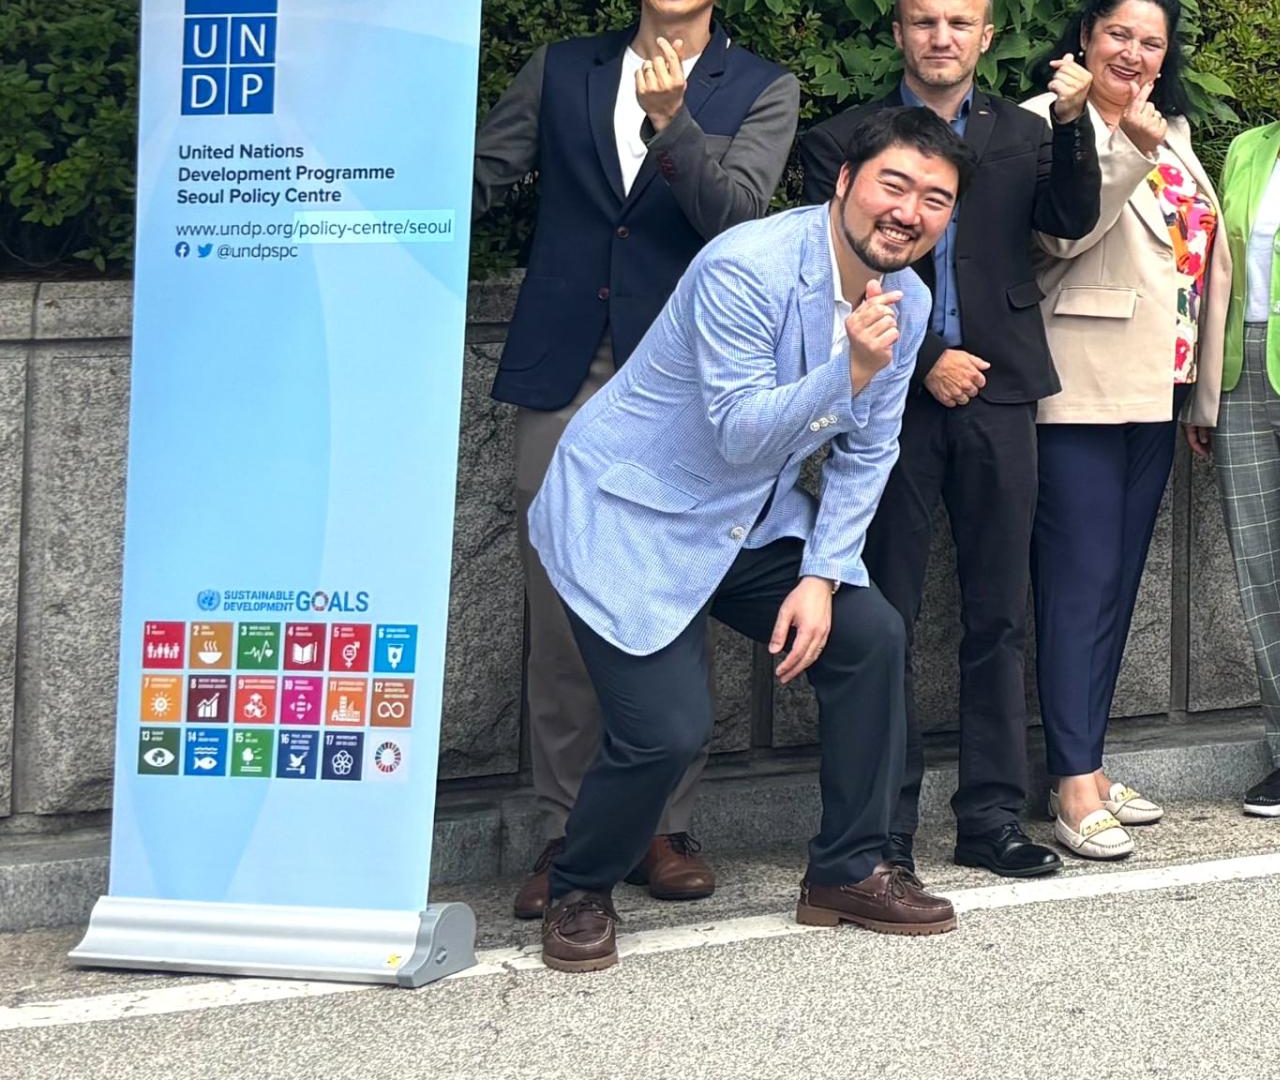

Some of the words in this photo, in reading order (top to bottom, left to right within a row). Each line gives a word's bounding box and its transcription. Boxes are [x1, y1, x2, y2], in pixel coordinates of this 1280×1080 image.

[179, 144, 234, 159] United
[240, 144, 304, 158] Nations
[179, 166, 291, 184] Development
[296, 165, 395, 184] Programme
[177, 188, 224, 204] Seoul
[230, 188, 280, 207] Policy
[285, 187, 342, 202] Centre
[176, 218, 452, 239] www.undp.org/policy-centre/seoul
[217, 243, 298, 261] @undpspc
[223, 601, 293, 611] DEVELOPMENT
[224, 590, 294, 601] SUSTAINABLE
[296, 591, 369, 612] GOALS
